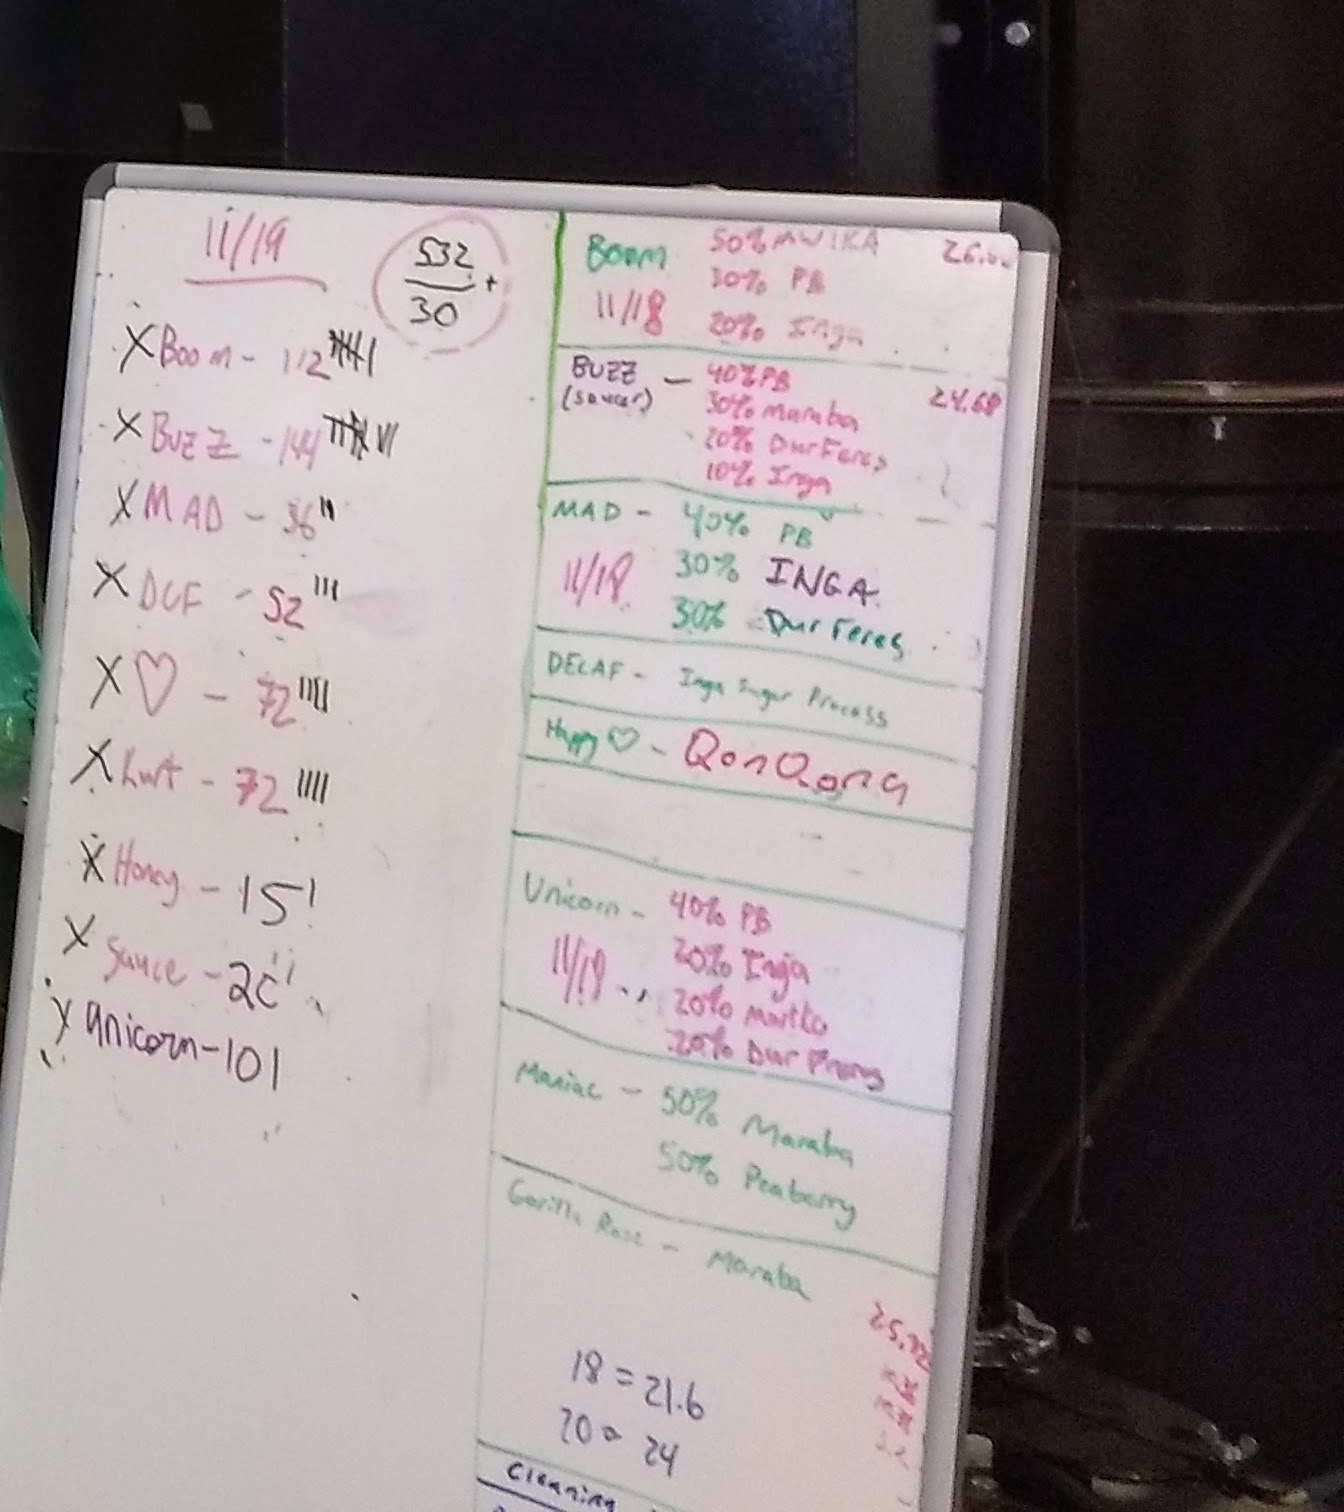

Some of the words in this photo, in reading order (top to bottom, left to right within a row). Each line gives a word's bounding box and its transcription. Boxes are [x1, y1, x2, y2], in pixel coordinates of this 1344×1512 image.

[415, 236, 476, 271] 532
[410, 298, 458, 328] 30
[551, 501, 622, 522] MAD
[675, 549, 739, 584] 30%
[765, 555, 881, 607] INGA
[569, 1348, 604, 1386] 18
[644, 1373, 706, 1421] 21.6
[560, 1406, 593, 1445] 20
[644, 1434, 680, 1478] 24
